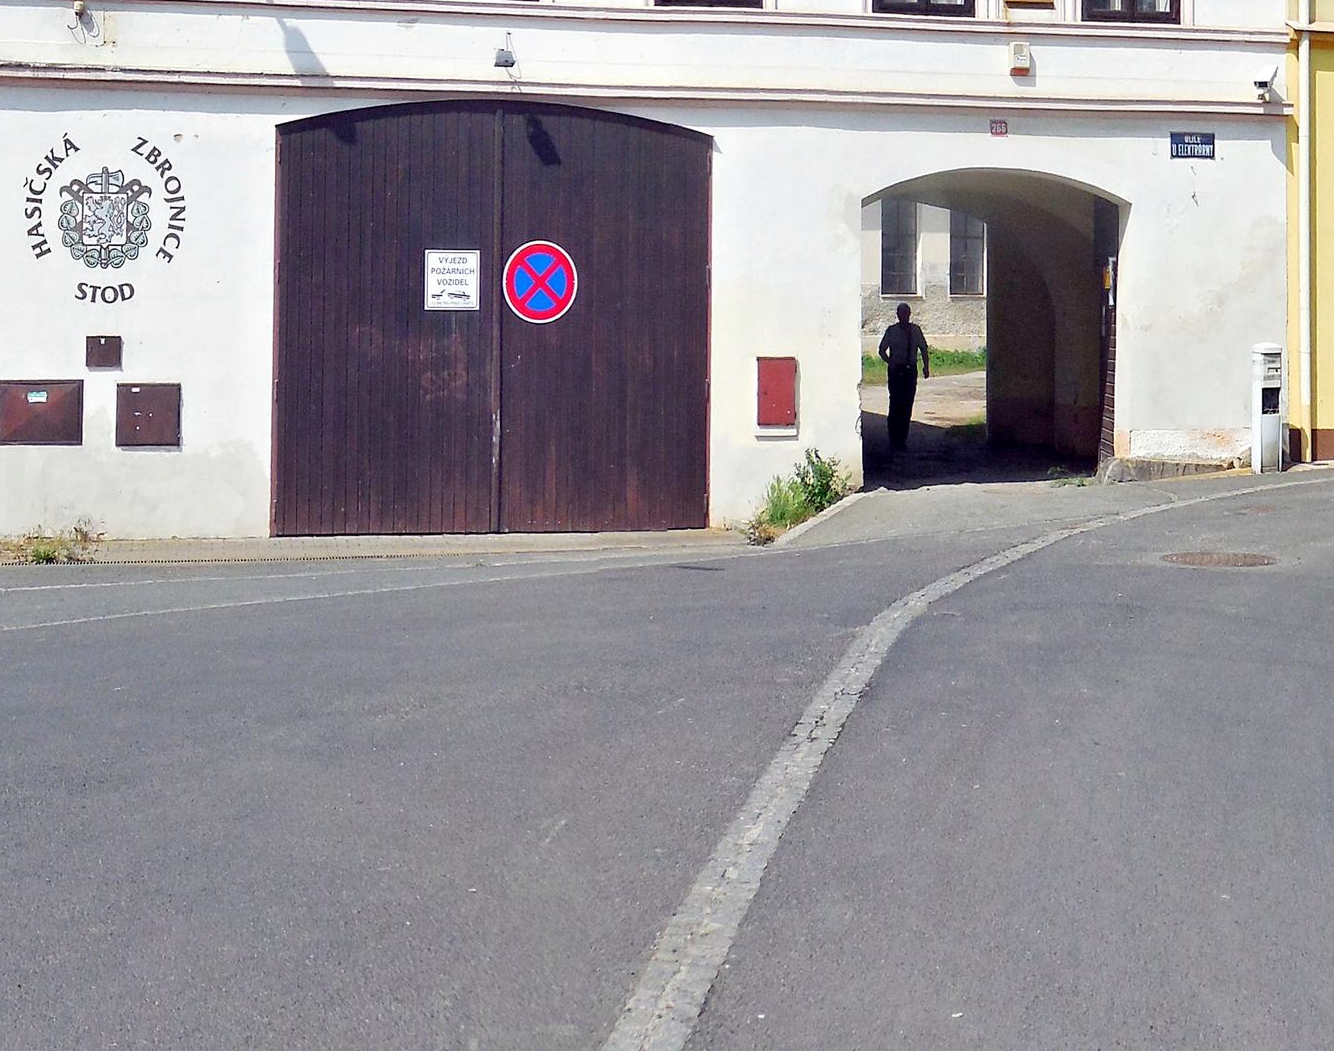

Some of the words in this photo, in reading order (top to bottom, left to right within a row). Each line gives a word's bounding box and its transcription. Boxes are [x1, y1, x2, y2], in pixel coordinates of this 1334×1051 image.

[1184, 134, 1201, 143] ULICE
[1172, 144, 1177, 156] U
[23, 132, 81, 260] HASIČSKÁ
[131, 136, 187, 264] ZBROJNICE
[436, 278, 470, 286] VOZIDEL
[74, 282, 135, 304] STOD
